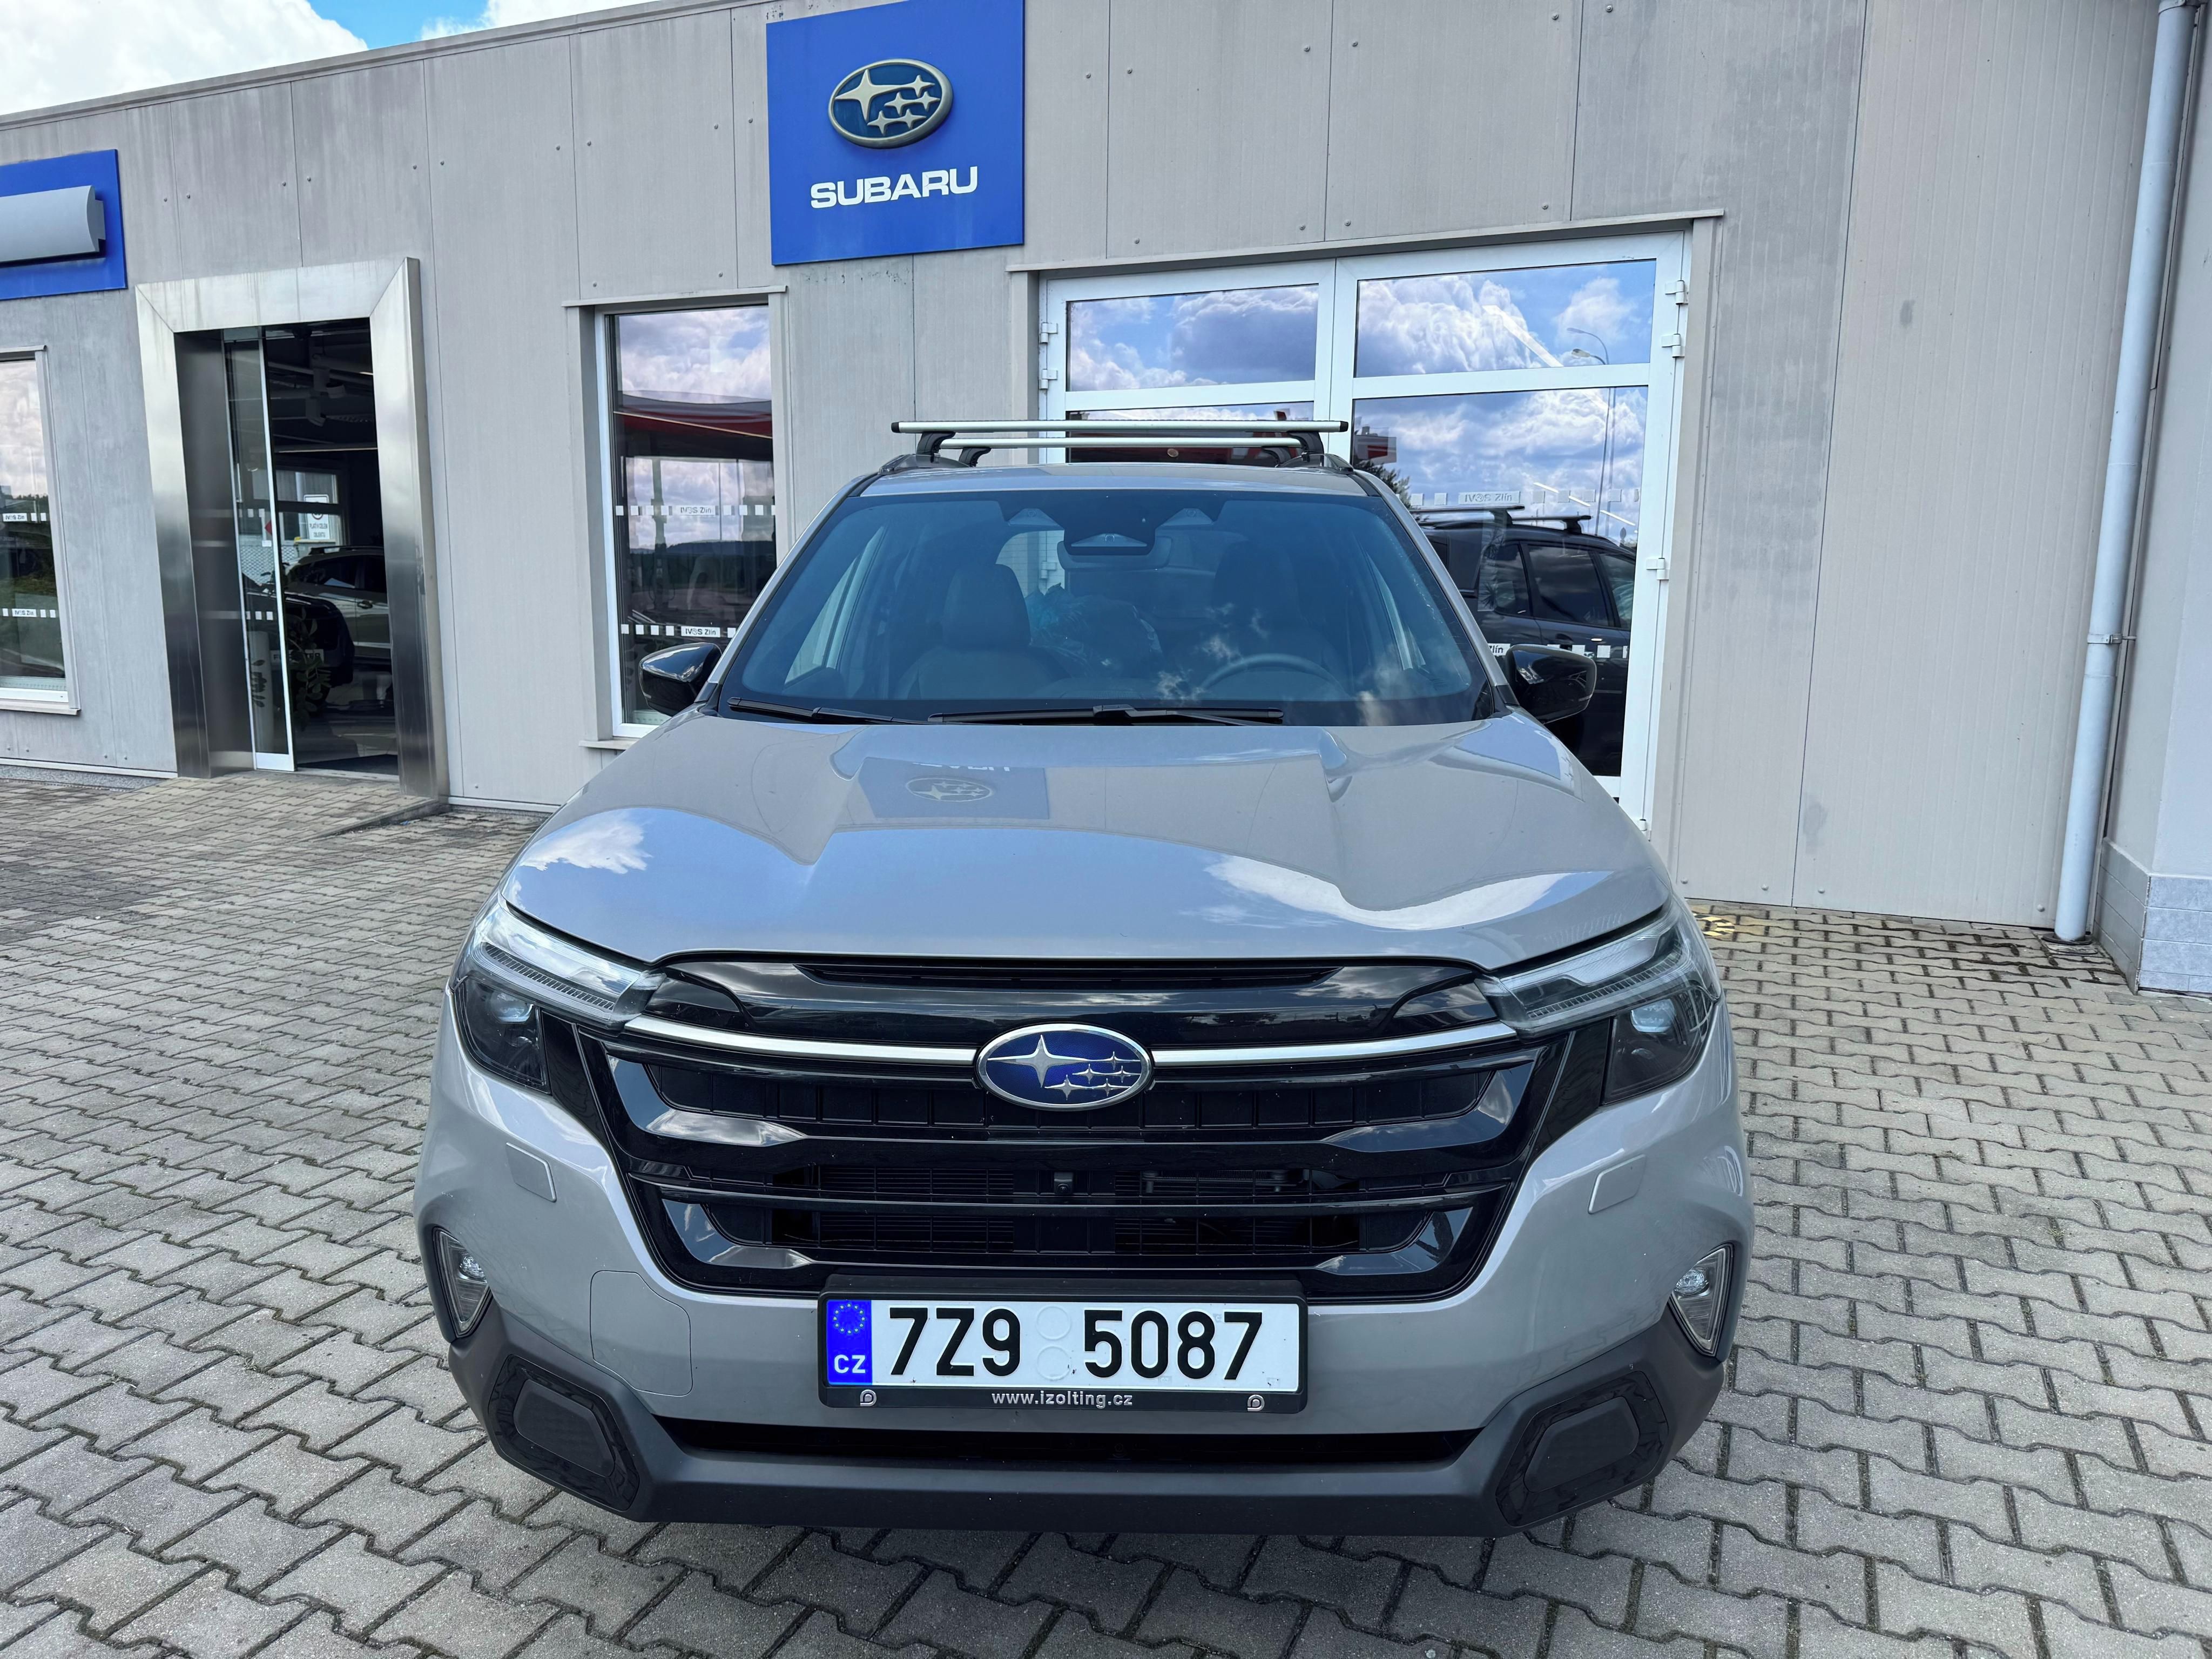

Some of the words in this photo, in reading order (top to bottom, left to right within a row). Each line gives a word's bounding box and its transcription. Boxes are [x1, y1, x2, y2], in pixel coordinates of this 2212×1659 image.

[811, 166, 978, 209] SUBARU
[889, 1307, 1021, 1377] 7Z9
[1084, 1310, 1263, 1380] 5087
[834, 1354, 866, 1373] CZ
[991, 1390, 1132, 1409] www.izolting.cz
